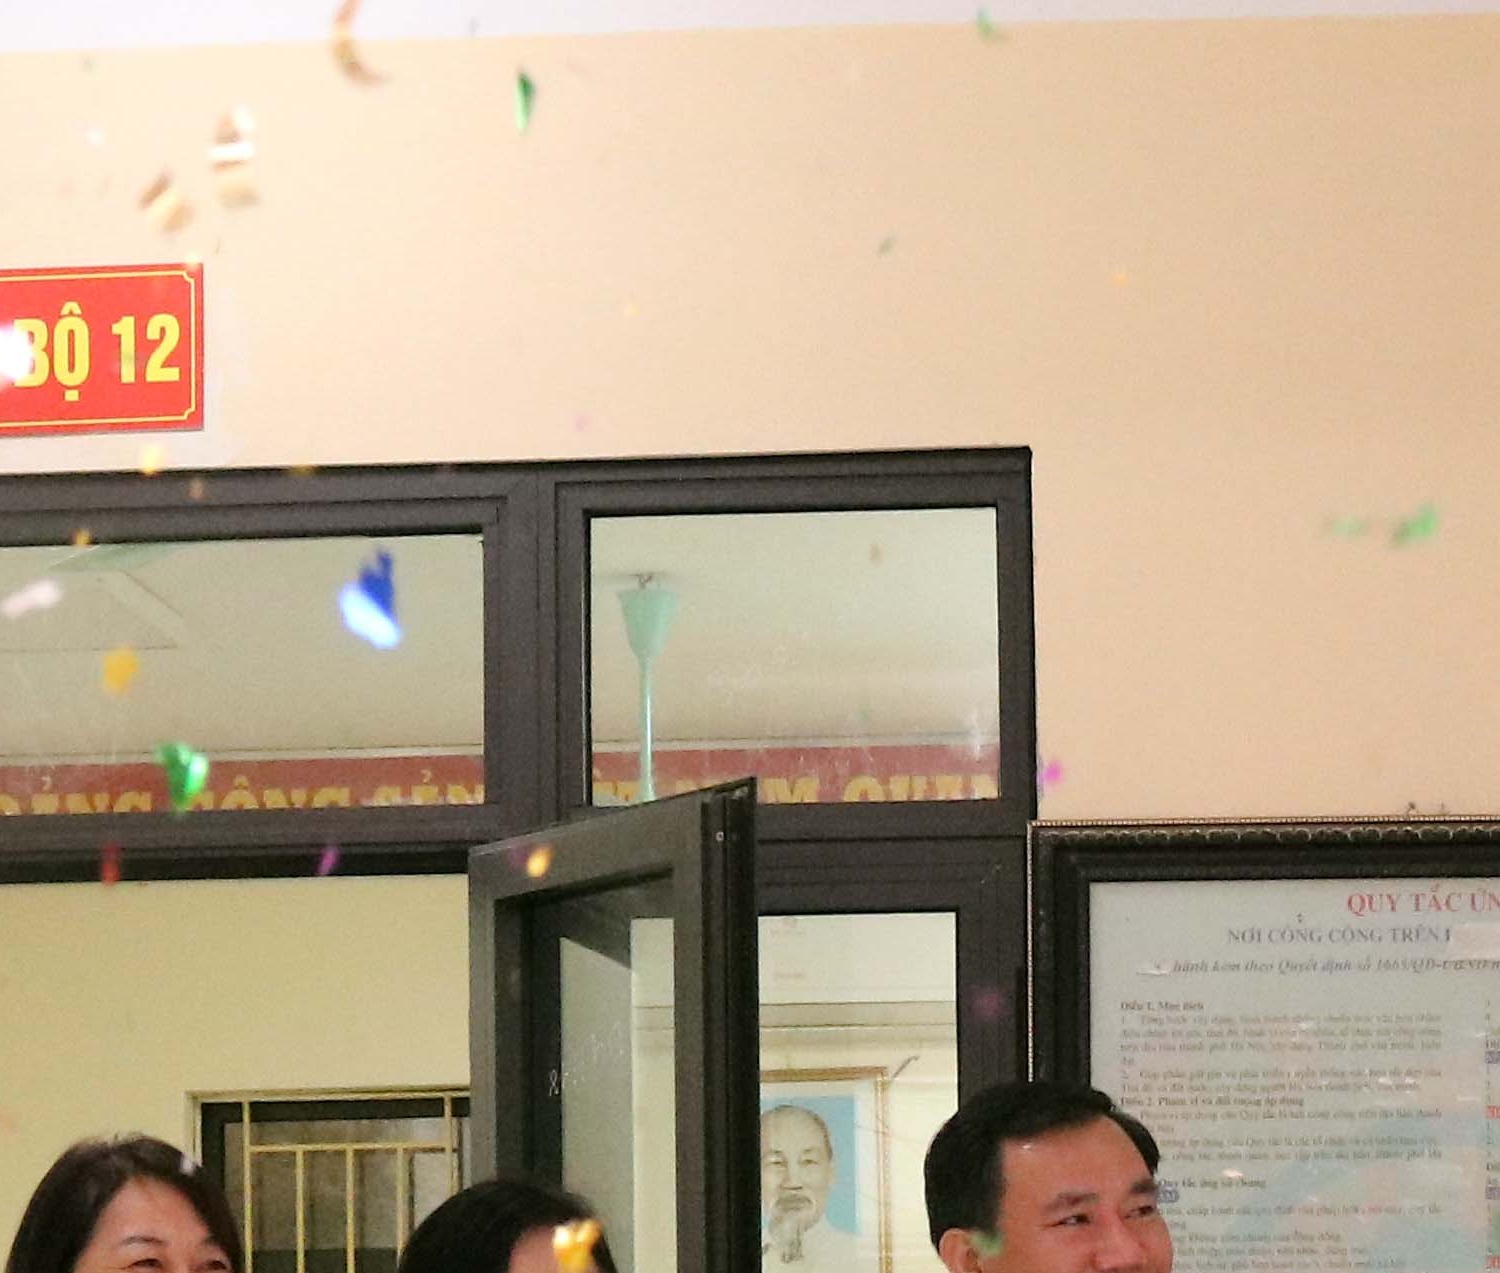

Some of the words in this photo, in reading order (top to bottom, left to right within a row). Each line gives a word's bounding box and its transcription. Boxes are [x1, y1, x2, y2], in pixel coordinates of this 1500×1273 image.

[111, 312, 181, 384] 12
[1346, 891, 1400, 917] QUY
[1411, 882, 1462, 912] TẮC
